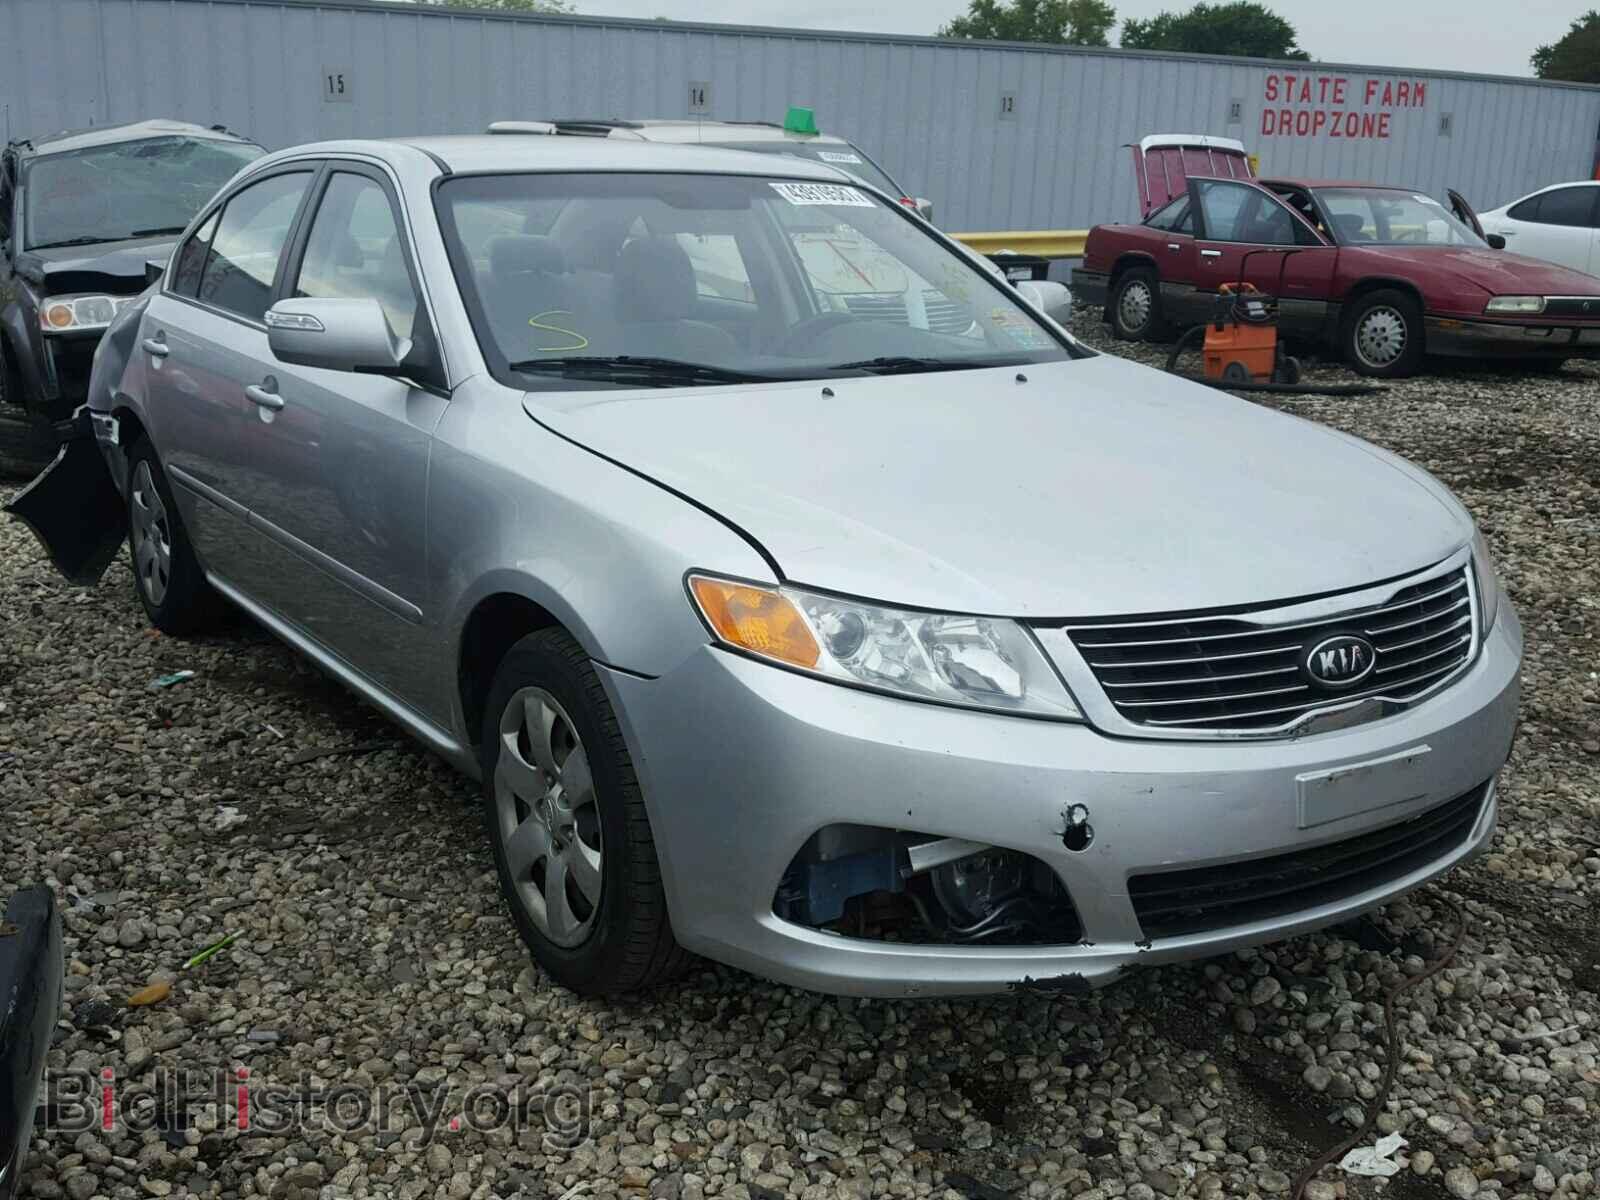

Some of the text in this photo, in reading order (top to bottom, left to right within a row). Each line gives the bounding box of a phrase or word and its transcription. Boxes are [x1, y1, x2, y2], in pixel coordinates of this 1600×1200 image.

[327, 74, 345, 94] 15
[691, 88, 705, 106] 14
[1265, 75, 1427, 108] STATE FARM
[1262, 109, 1392, 139] DROPZONE
[1318, 645, 1367, 677] KIA
